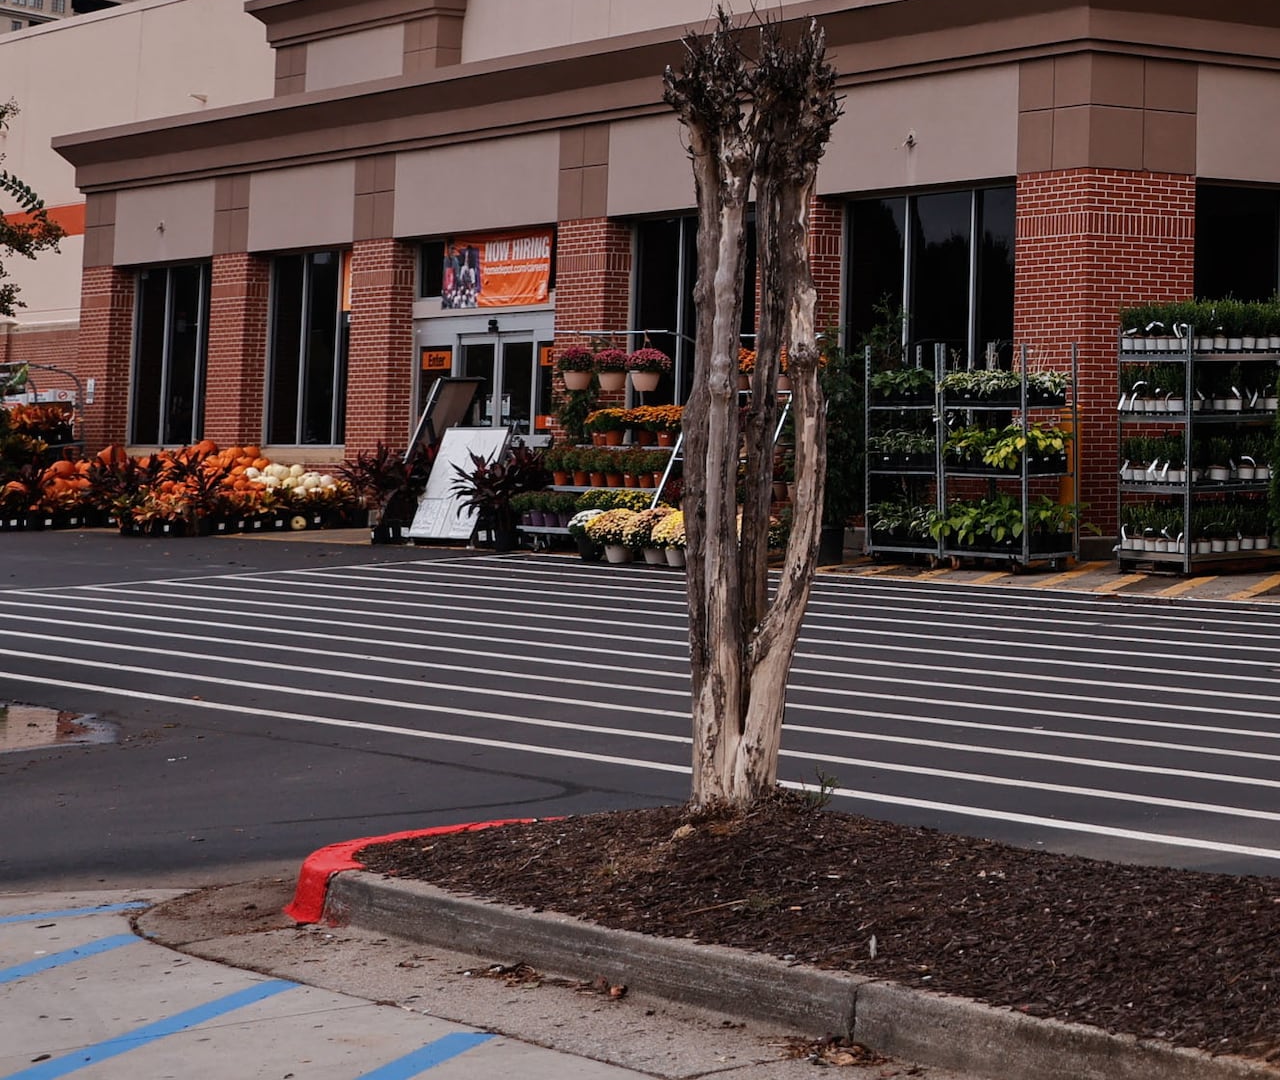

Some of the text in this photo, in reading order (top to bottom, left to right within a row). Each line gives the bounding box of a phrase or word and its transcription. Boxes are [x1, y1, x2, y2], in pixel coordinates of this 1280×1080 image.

[485, 236, 550, 262] NOW HIRING
[428, 354, 446, 367] Enter
